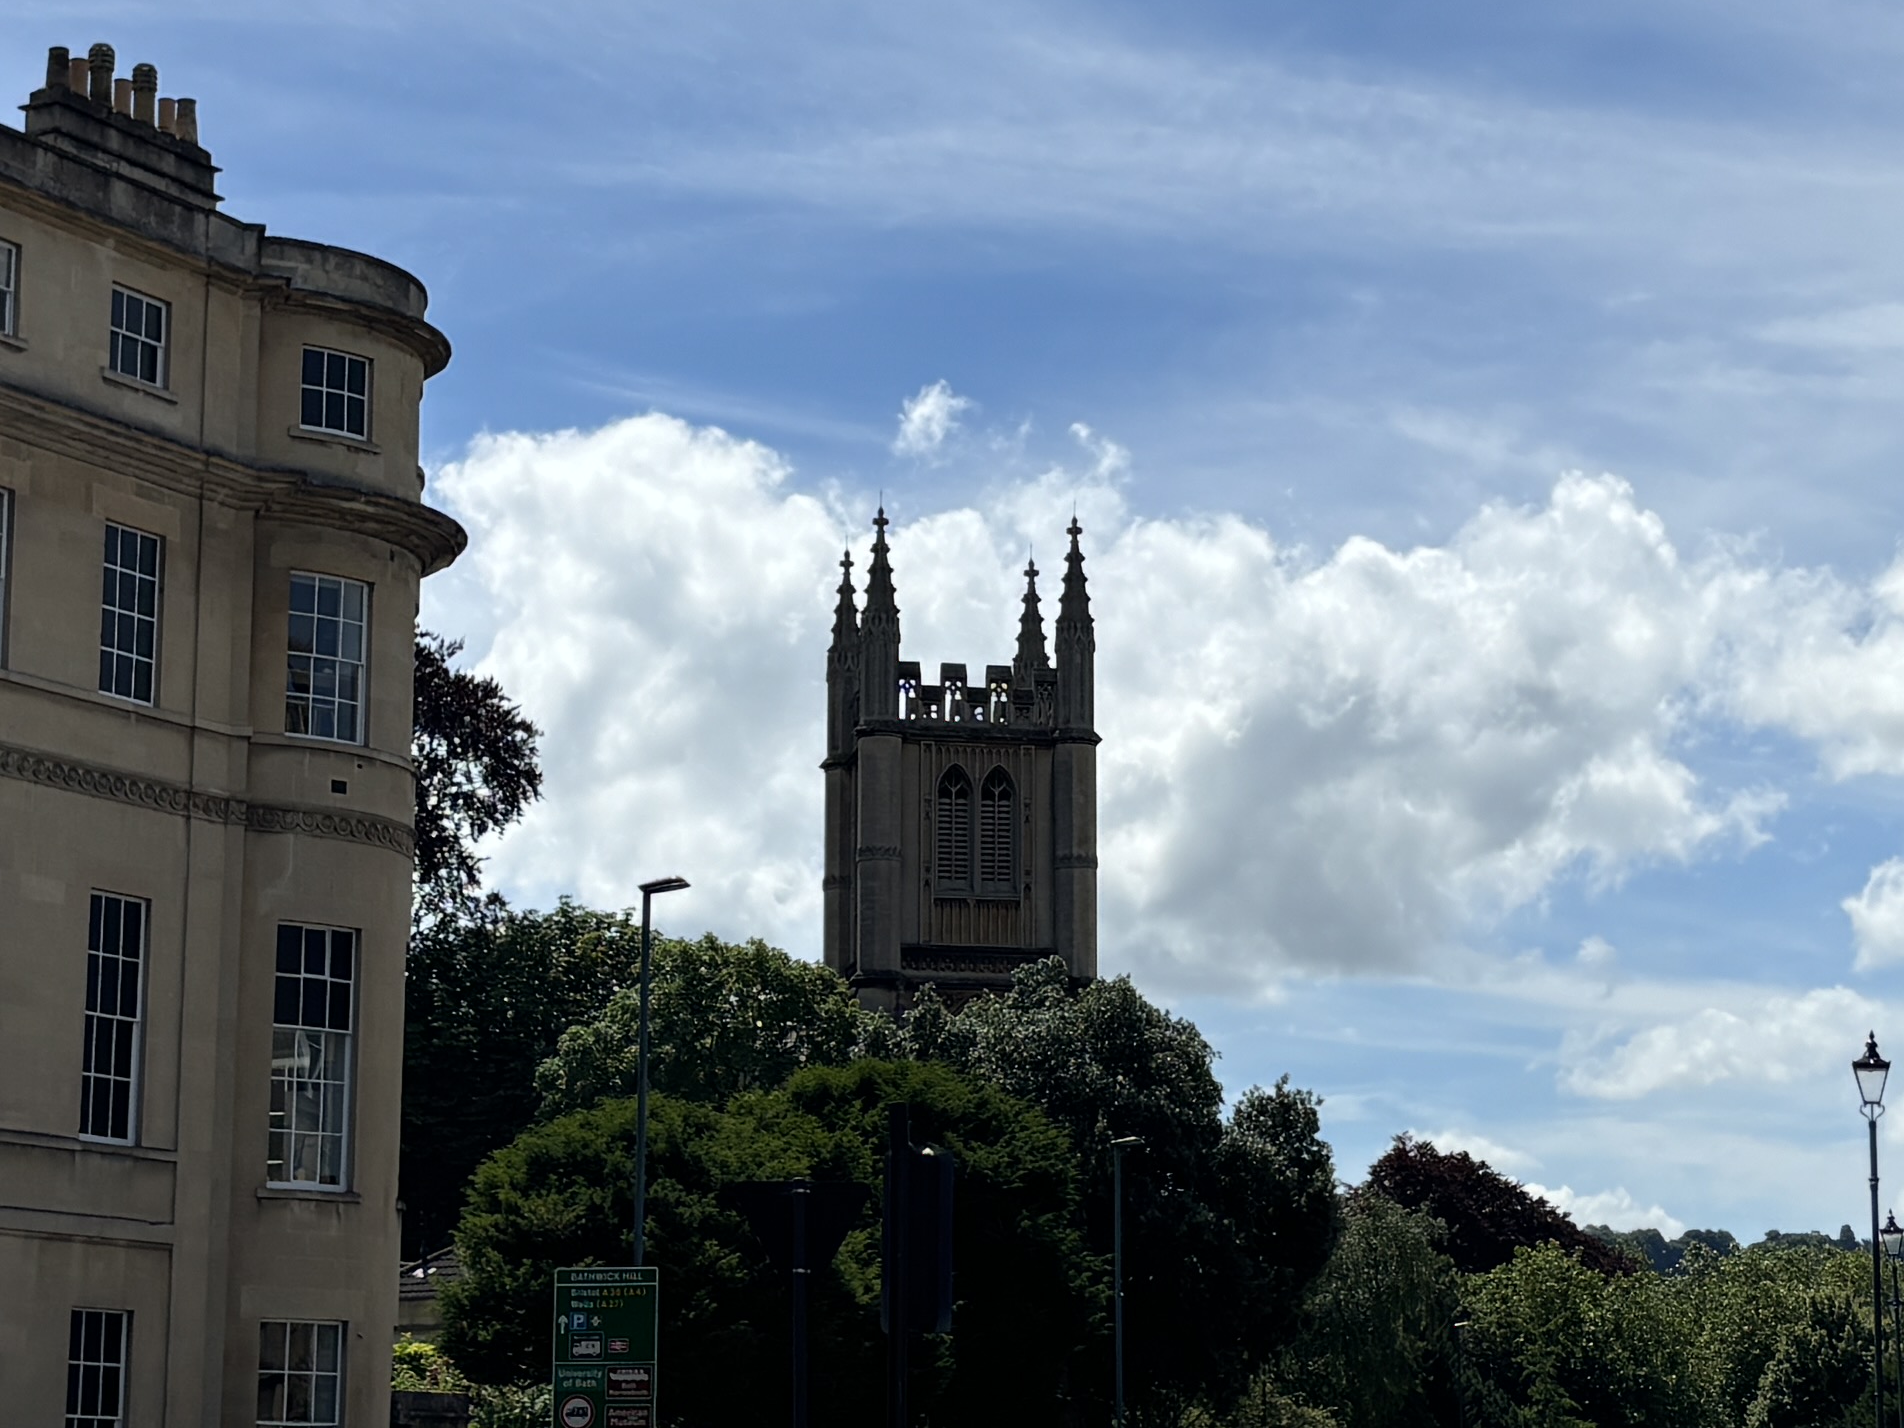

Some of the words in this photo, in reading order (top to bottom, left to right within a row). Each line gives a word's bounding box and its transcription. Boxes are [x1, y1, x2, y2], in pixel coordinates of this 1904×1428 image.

[570, 1271, 620, 1281] BATHWICK
[622, 1271, 643, 1281] HILL
[558, 1368, 602, 1379] University
[575, 1378, 597, 1388] Bath
[607, 1408, 648, 1417] American
